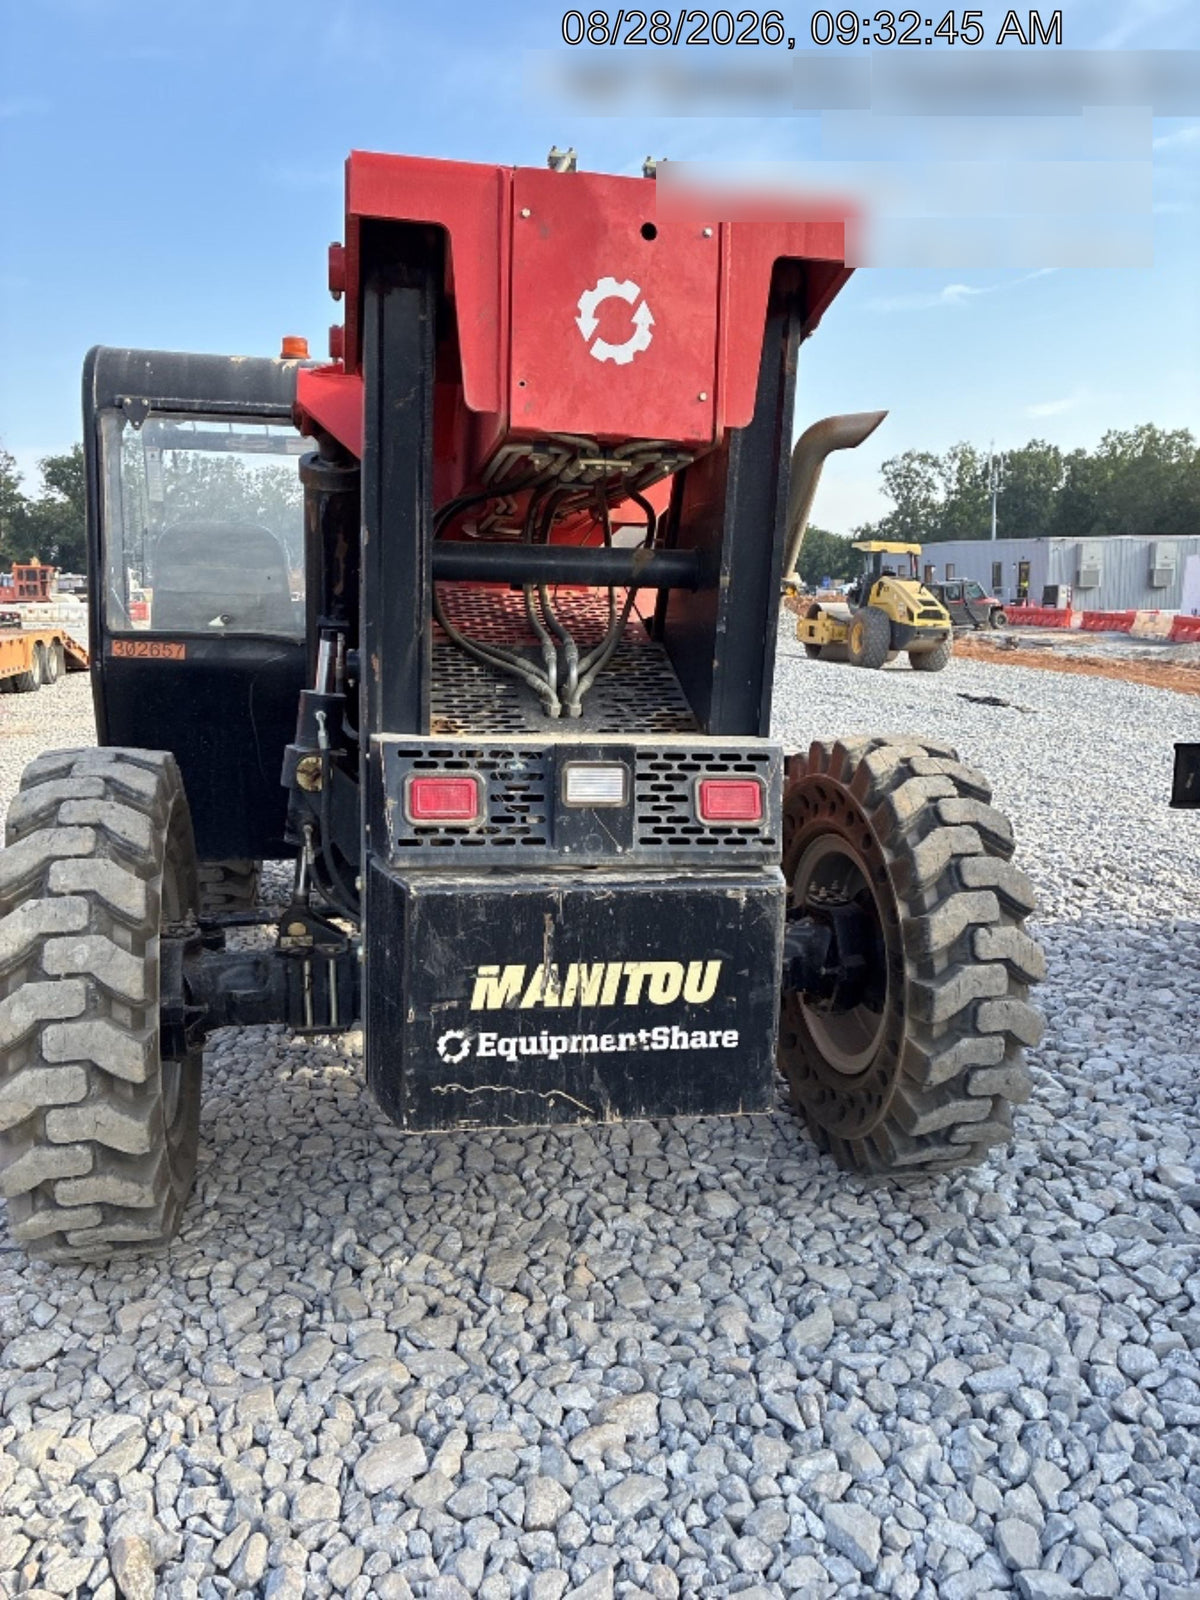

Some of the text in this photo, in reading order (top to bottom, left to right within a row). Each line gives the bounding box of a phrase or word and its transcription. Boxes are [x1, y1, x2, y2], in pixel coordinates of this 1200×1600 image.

[112, 641, 185, 659] 302657
[470, 960, 723, 1011] MANITOU
[475, 1025, 739, 1062] EquipmentShare
